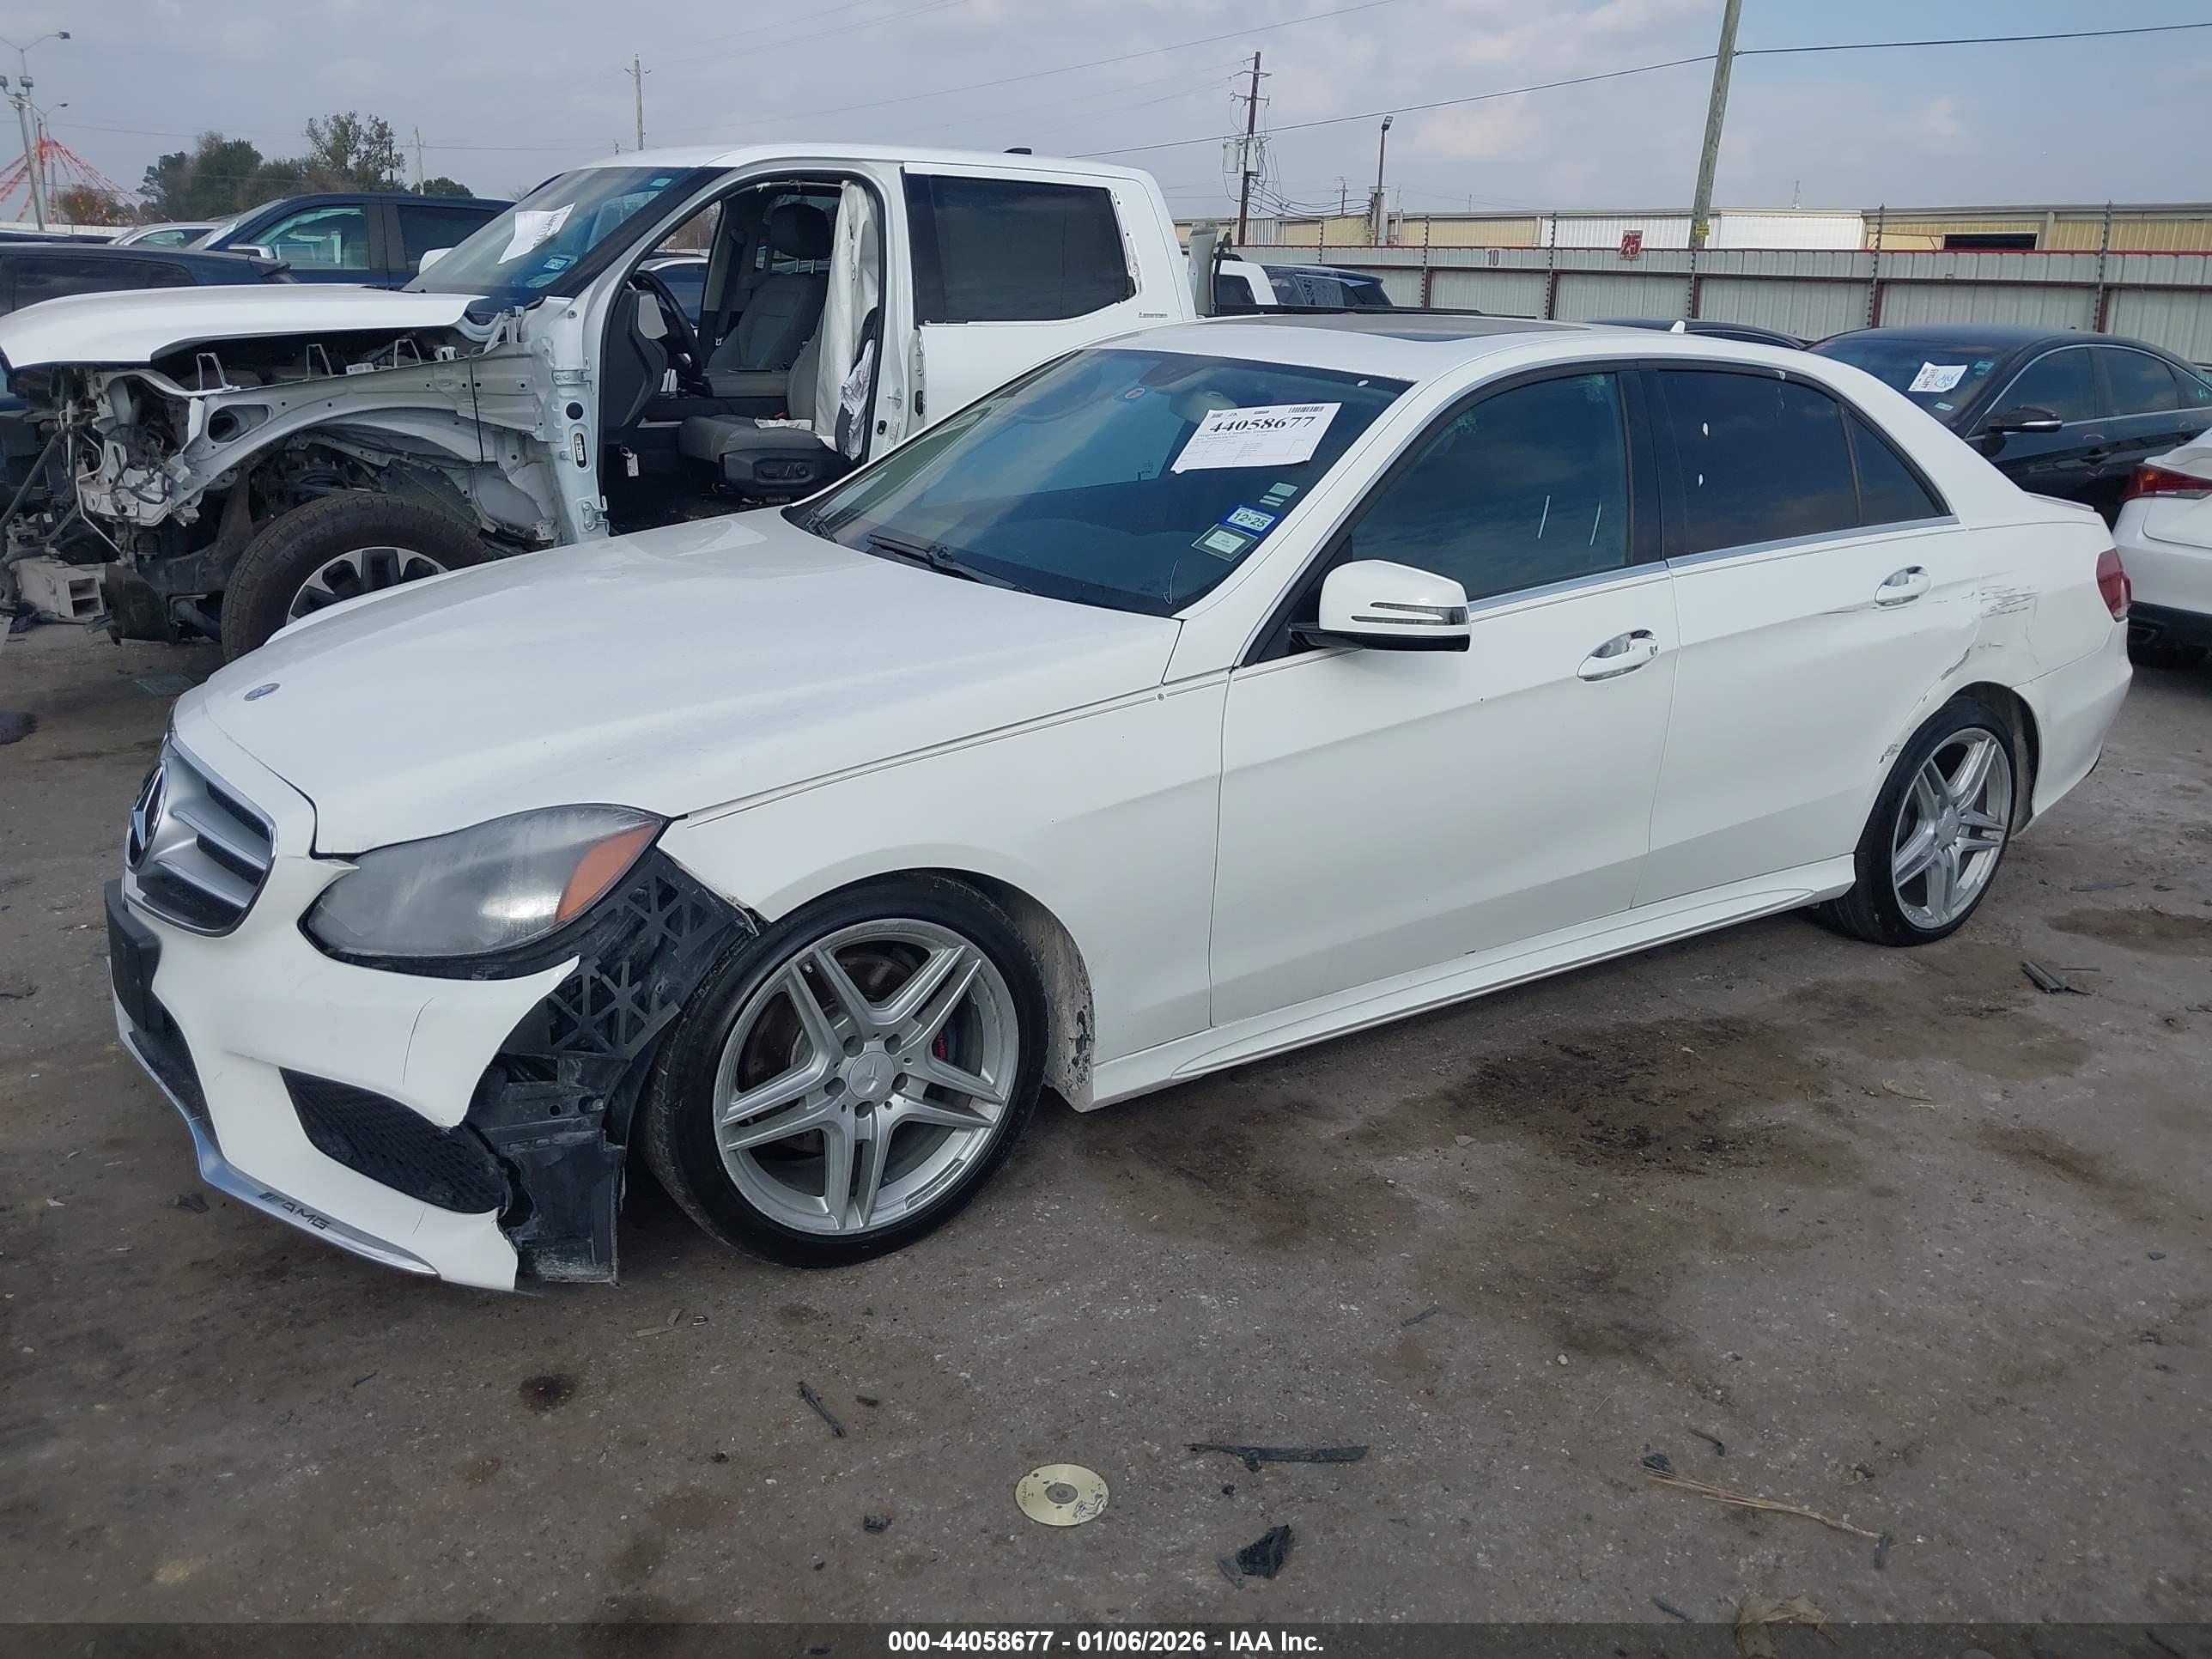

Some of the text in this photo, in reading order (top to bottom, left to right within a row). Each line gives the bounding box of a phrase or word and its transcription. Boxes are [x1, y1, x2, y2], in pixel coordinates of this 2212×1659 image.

[1621, 234, 1641, 255] 25
[1487, 249, 1499, 266] 10
[1209, 416, 1316, 432] 44058677
[283, 1201, 331, 1230] AMG
